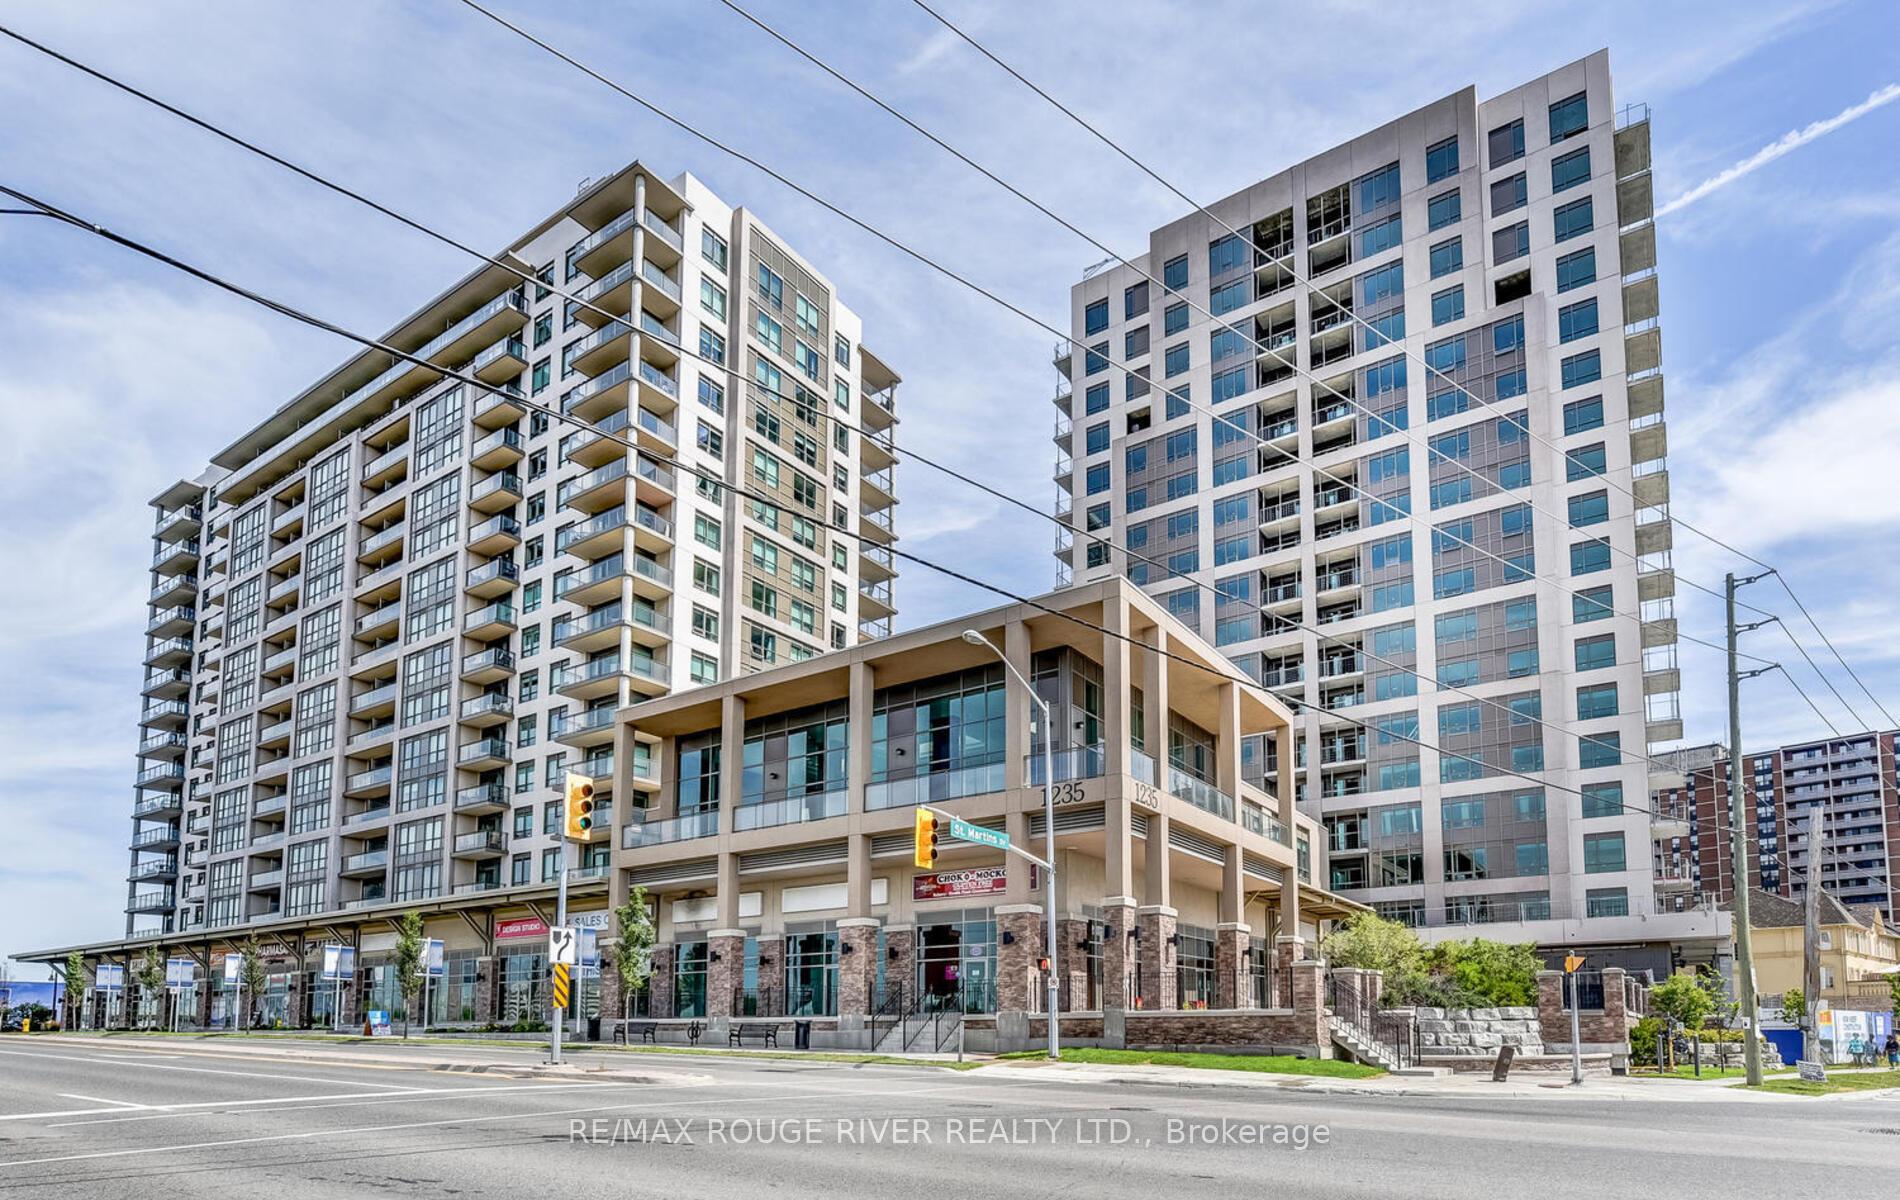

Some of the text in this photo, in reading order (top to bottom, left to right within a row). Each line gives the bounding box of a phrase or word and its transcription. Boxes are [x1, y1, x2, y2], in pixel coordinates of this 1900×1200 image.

[1041, 782, 1084, 807] 1235
[1135, 783, 1158, 809] 1235
[968, 827, 998, 844] Martins
[575, 915, 602, 926] SALES
